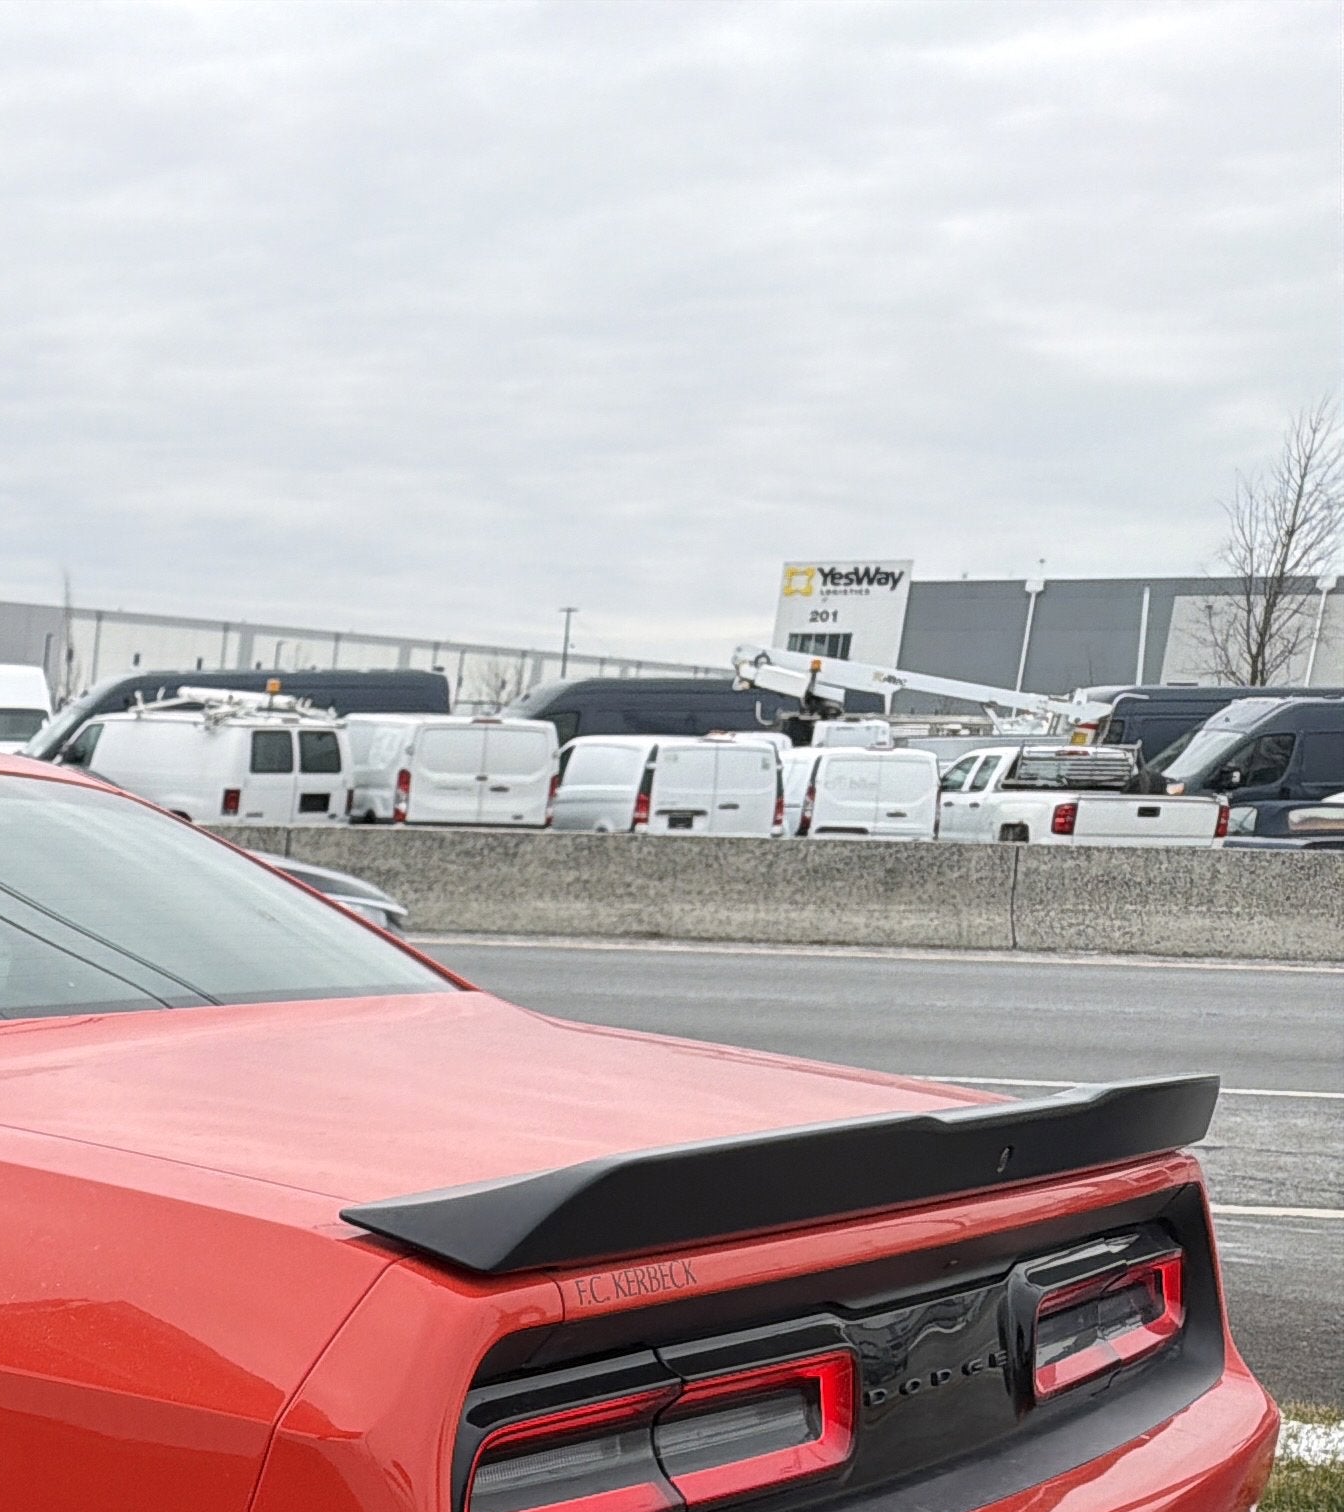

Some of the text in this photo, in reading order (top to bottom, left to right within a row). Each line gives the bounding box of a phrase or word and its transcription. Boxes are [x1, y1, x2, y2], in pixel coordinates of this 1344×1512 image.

[817, 566, 905, 591] YesWay
[809, 609, 839, 623] 201
[575, 1260, 697, 1305] F.C. KERBECK
[864, 1351, 1009, 1406] DODGE
